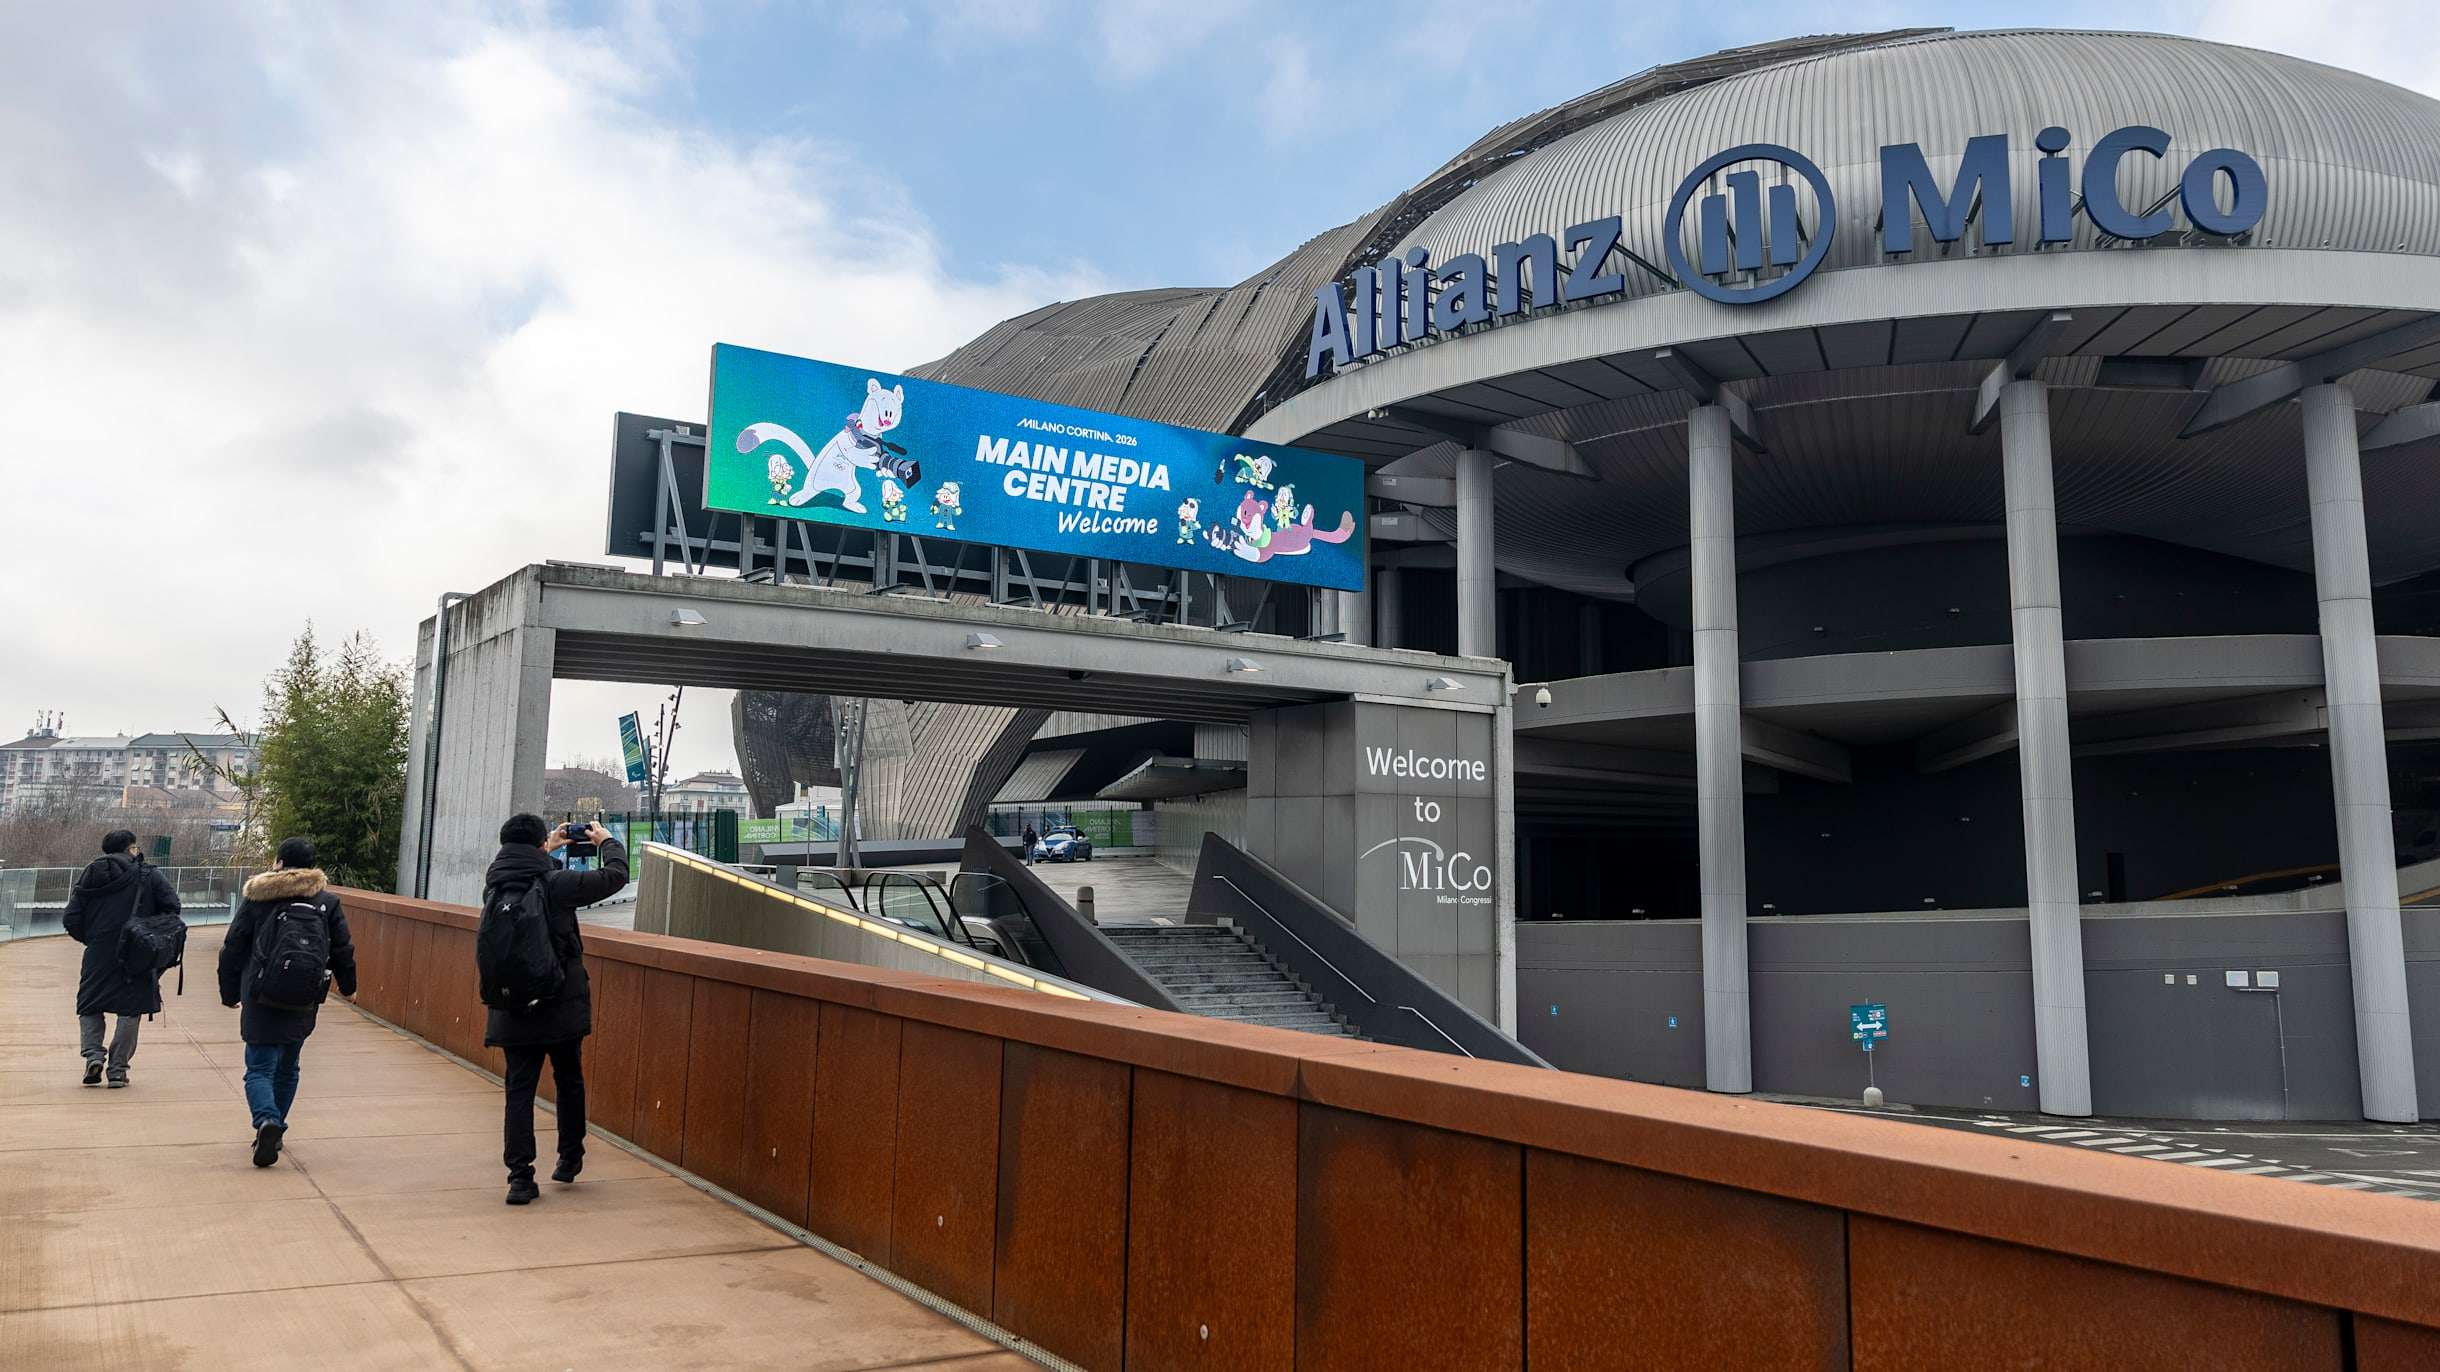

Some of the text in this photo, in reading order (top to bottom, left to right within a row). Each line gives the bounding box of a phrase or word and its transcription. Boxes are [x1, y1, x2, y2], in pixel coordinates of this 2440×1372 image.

[1305, 125, 2268, 380] Allianz MiCo
[1016, 418, 1137, 447] MILANO CORTINA 2026
[975, 434, 1171, 491] MAIN MEDIA
[1003, 469, 1128, 512] CENTRE
[1058, 510, 1159, 534] Welcome
[1366, 746, 1485, 781] Welcome
[1414, 796, 1441, 823] to
[1400, 851, 1492, 891] MiCo
[1460, 895, 1492, 906] Congressi
